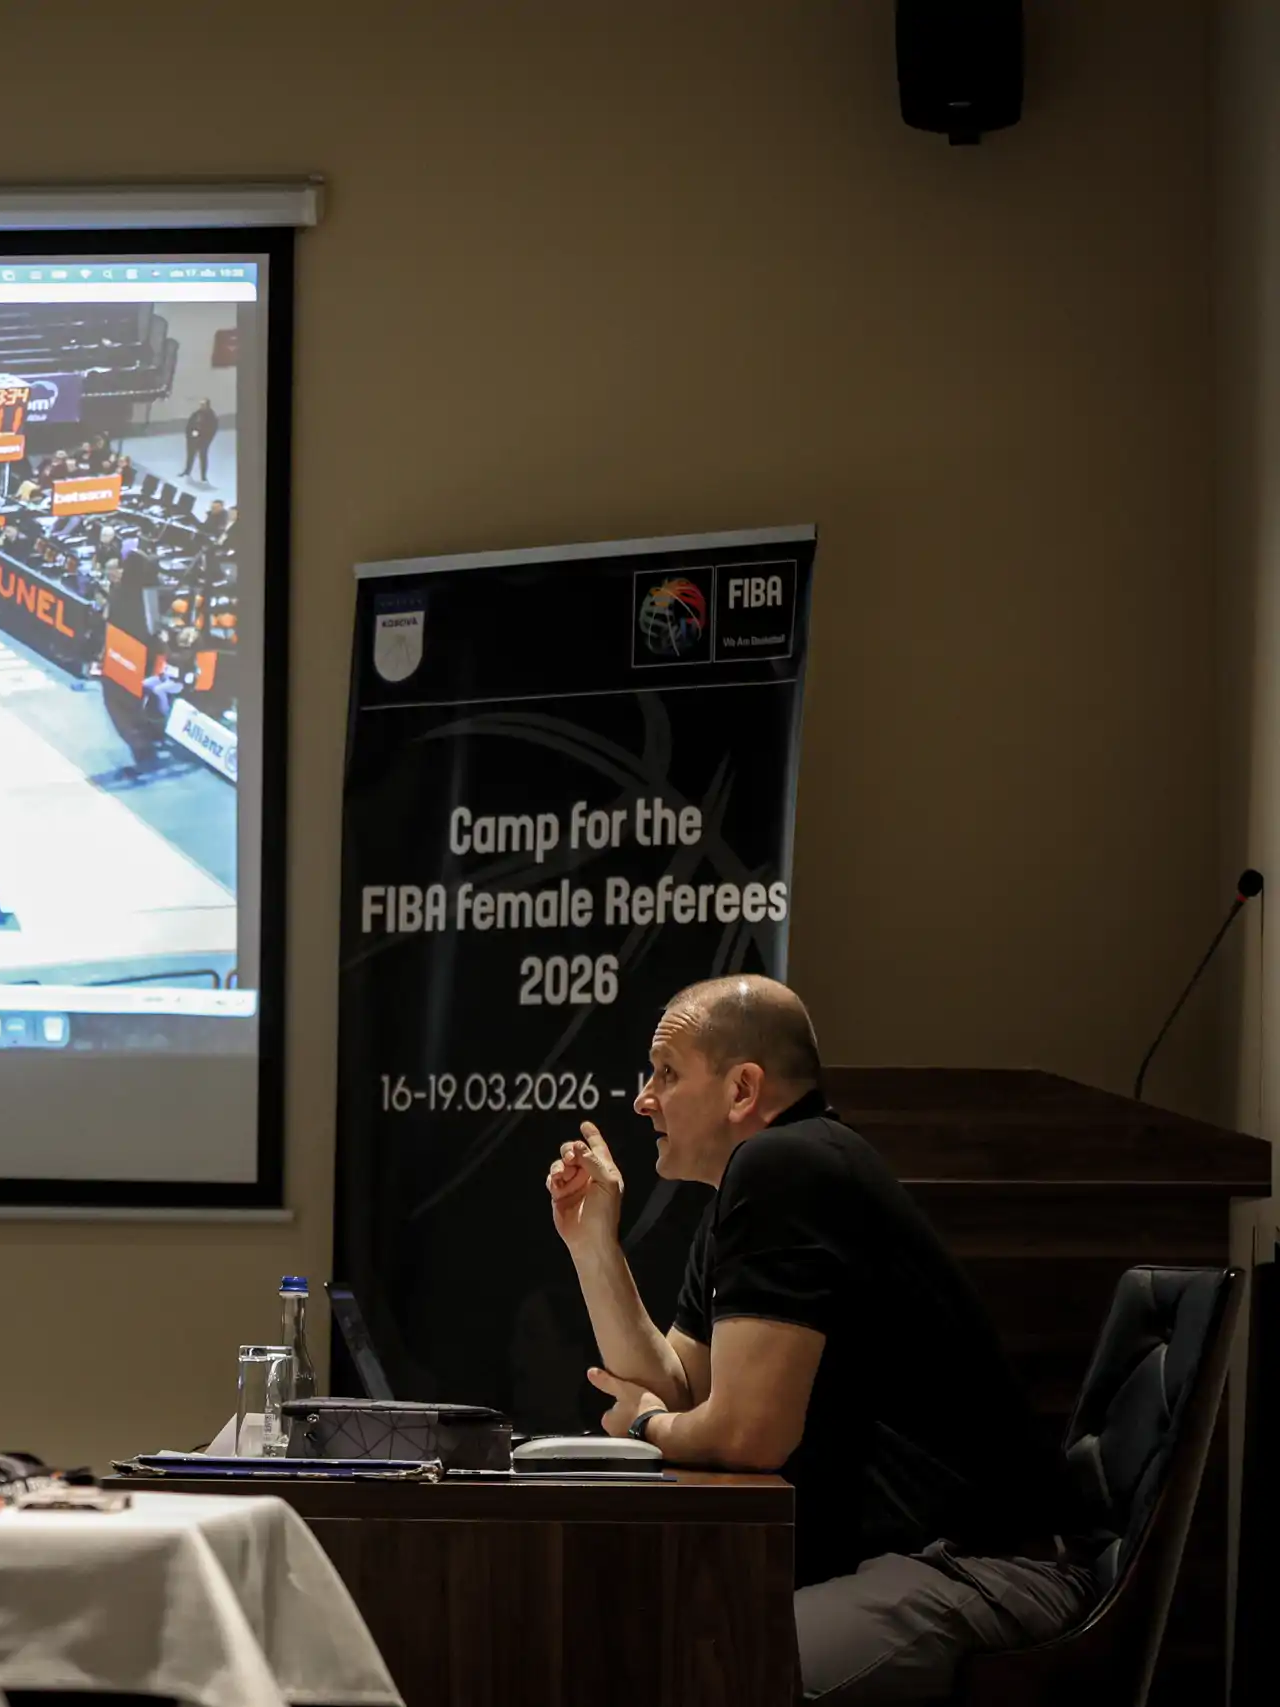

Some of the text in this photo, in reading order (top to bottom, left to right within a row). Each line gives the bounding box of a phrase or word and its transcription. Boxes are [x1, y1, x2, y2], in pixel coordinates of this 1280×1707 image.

[729, 575, 783, 609] FIBA
[182, 719, 224, 758] Allianz
[450, 797, 703, 863] Camp for the
[362, 875, 788, 933] FIBA female Referees
[520, 954, 619, 1006] 2026
[380, 1072, 600, 1112] 16-19.03.2026
